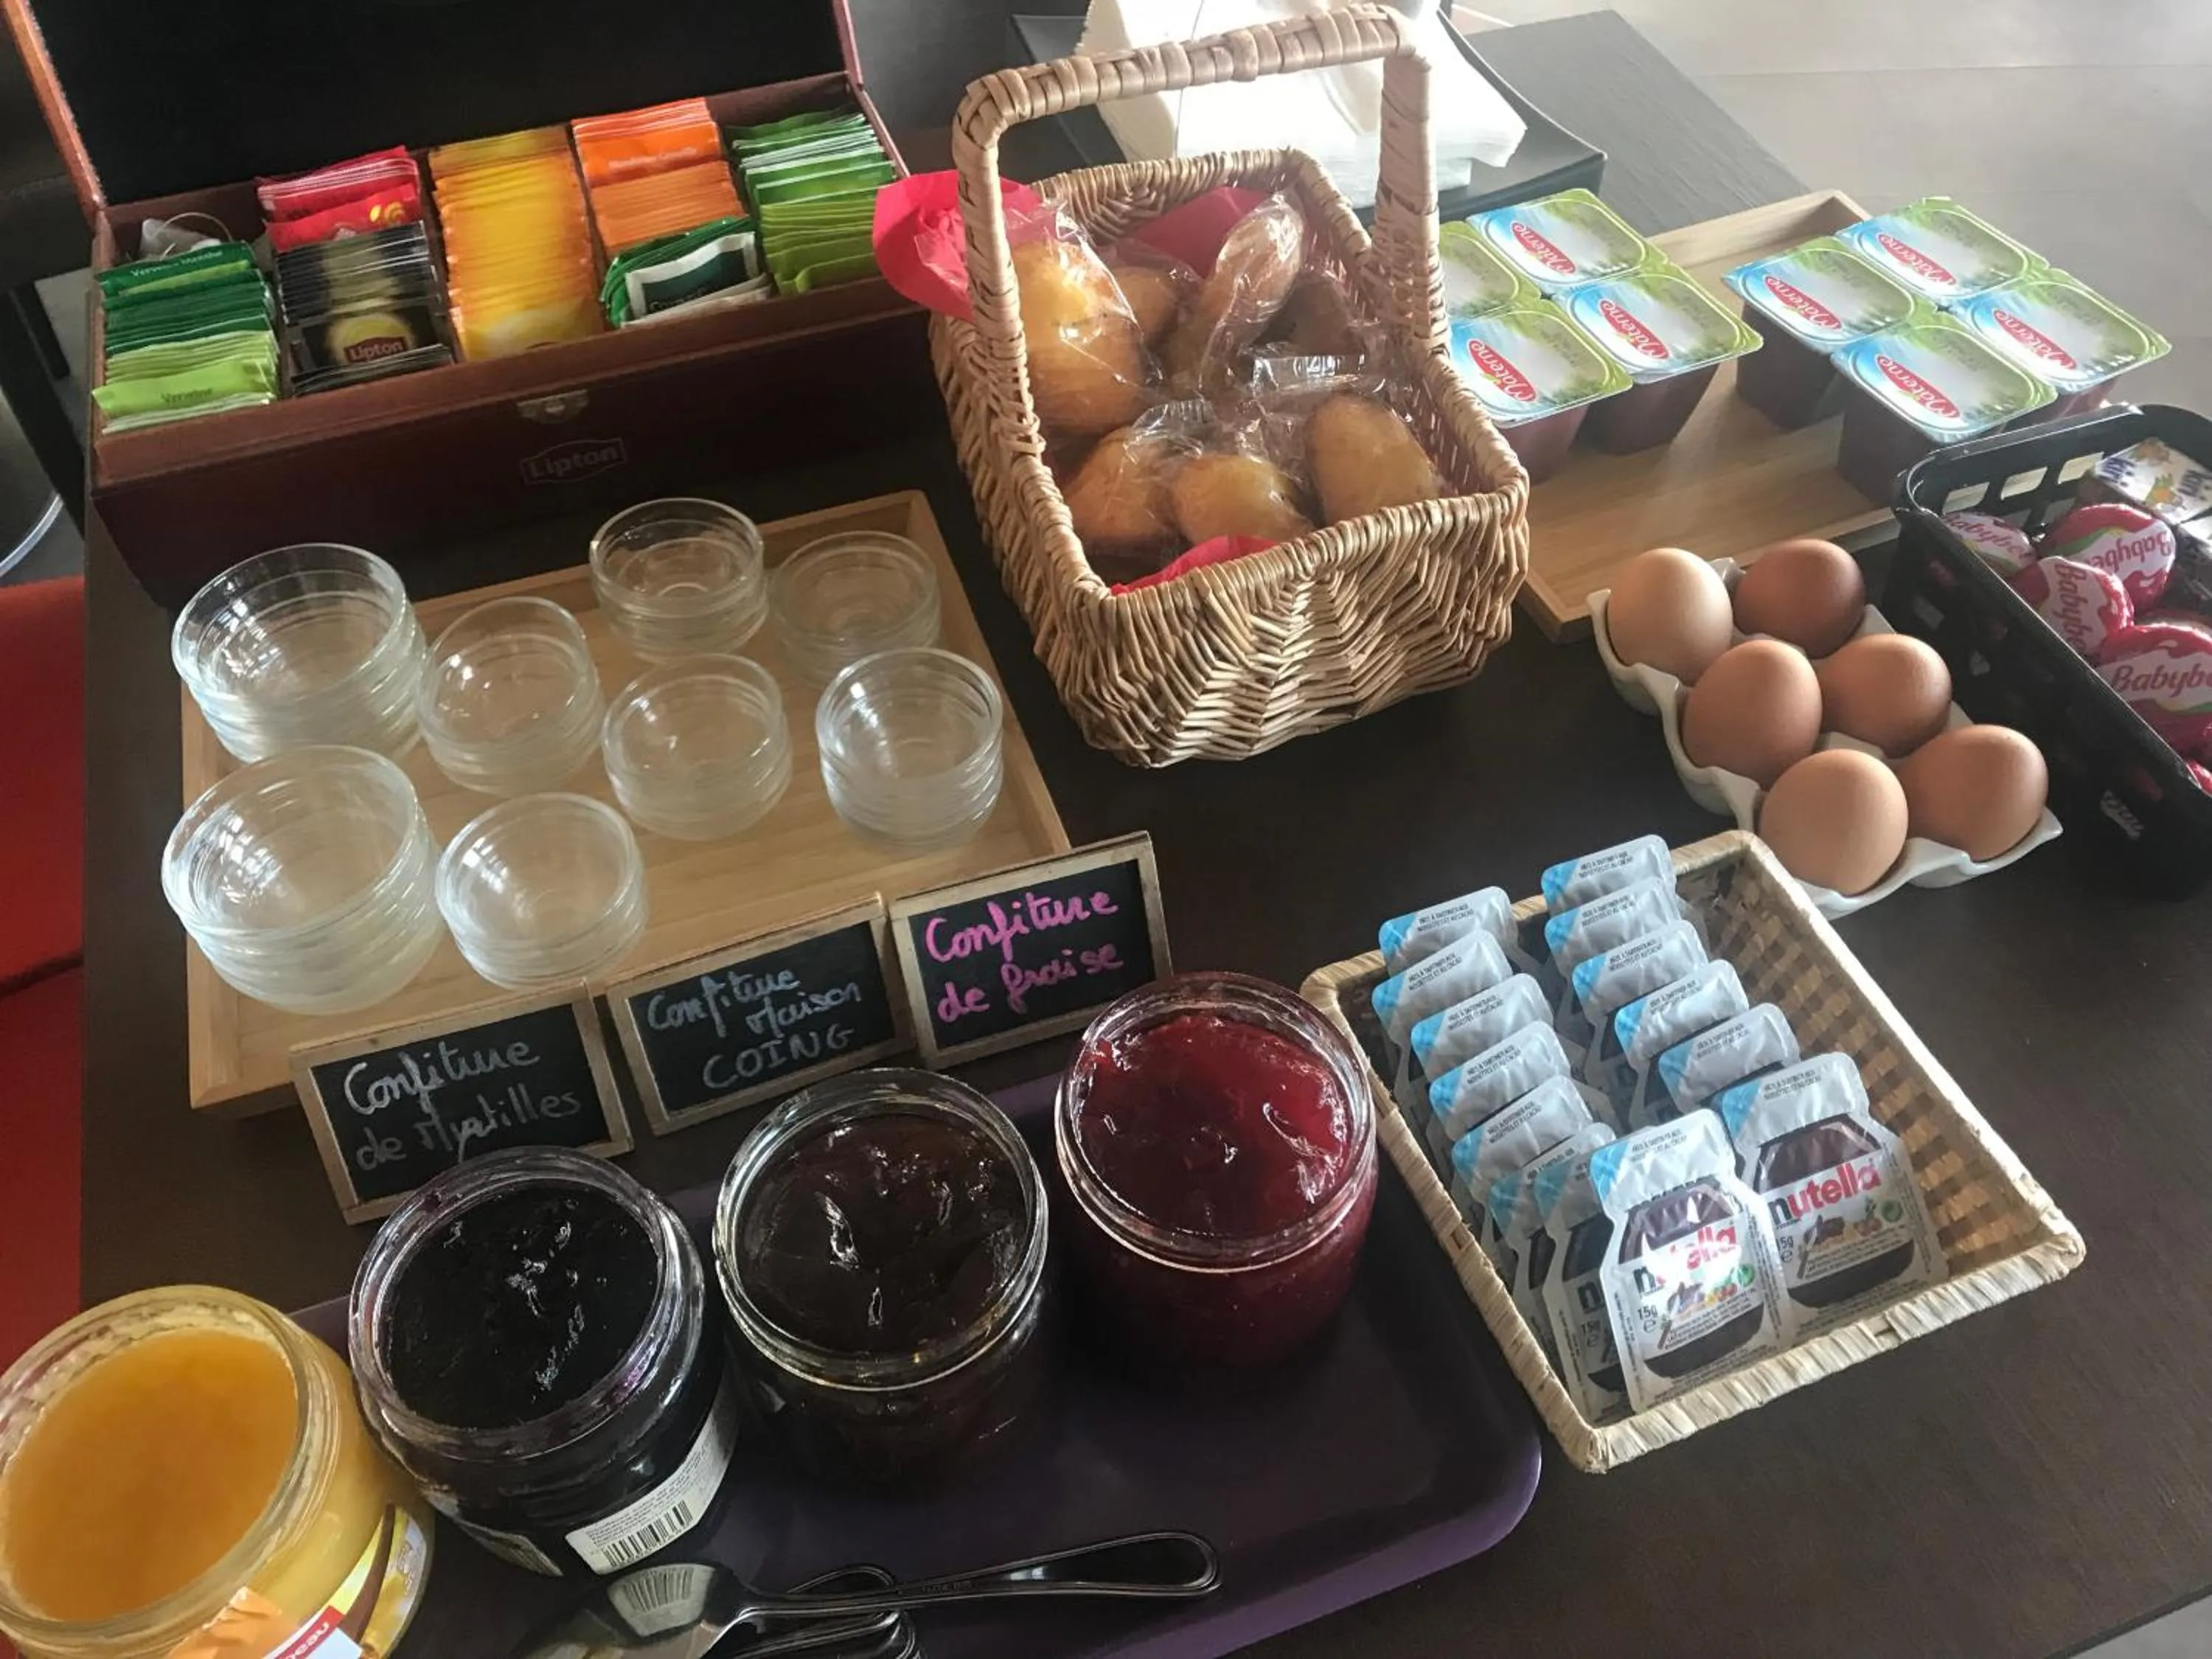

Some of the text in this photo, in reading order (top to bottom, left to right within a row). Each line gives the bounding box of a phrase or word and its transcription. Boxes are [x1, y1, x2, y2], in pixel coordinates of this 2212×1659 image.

[1512, 221, 1576, 275] Materne
[1600, 300, 1670, 360] Materne
[1764, 276, 1843, 330] Materne
[349, 341, 405, 361] Lipton
[1467, 340, 1537, 402] Materne
[1877, 355, 1961, 419] Materne
[529, 445, 620, 477] Lipton
[2085, 531, 2172, 573] Babybe
[2053, 563, 2088, 652] Babybe
[925, 891, 1119, 963] Confiture
[745, 981, 861, 1038] Maison
[937, 943, 1124, 1023] de fraise
[344, 1040, 540, 1115] Confiture
[703, 1022, 855, 1089] COING
[355, 1127, 407, 1171] de
[1768, 1163, 1882, 1225] nutella
[1637, 1304, 1658, 1320] 15g
